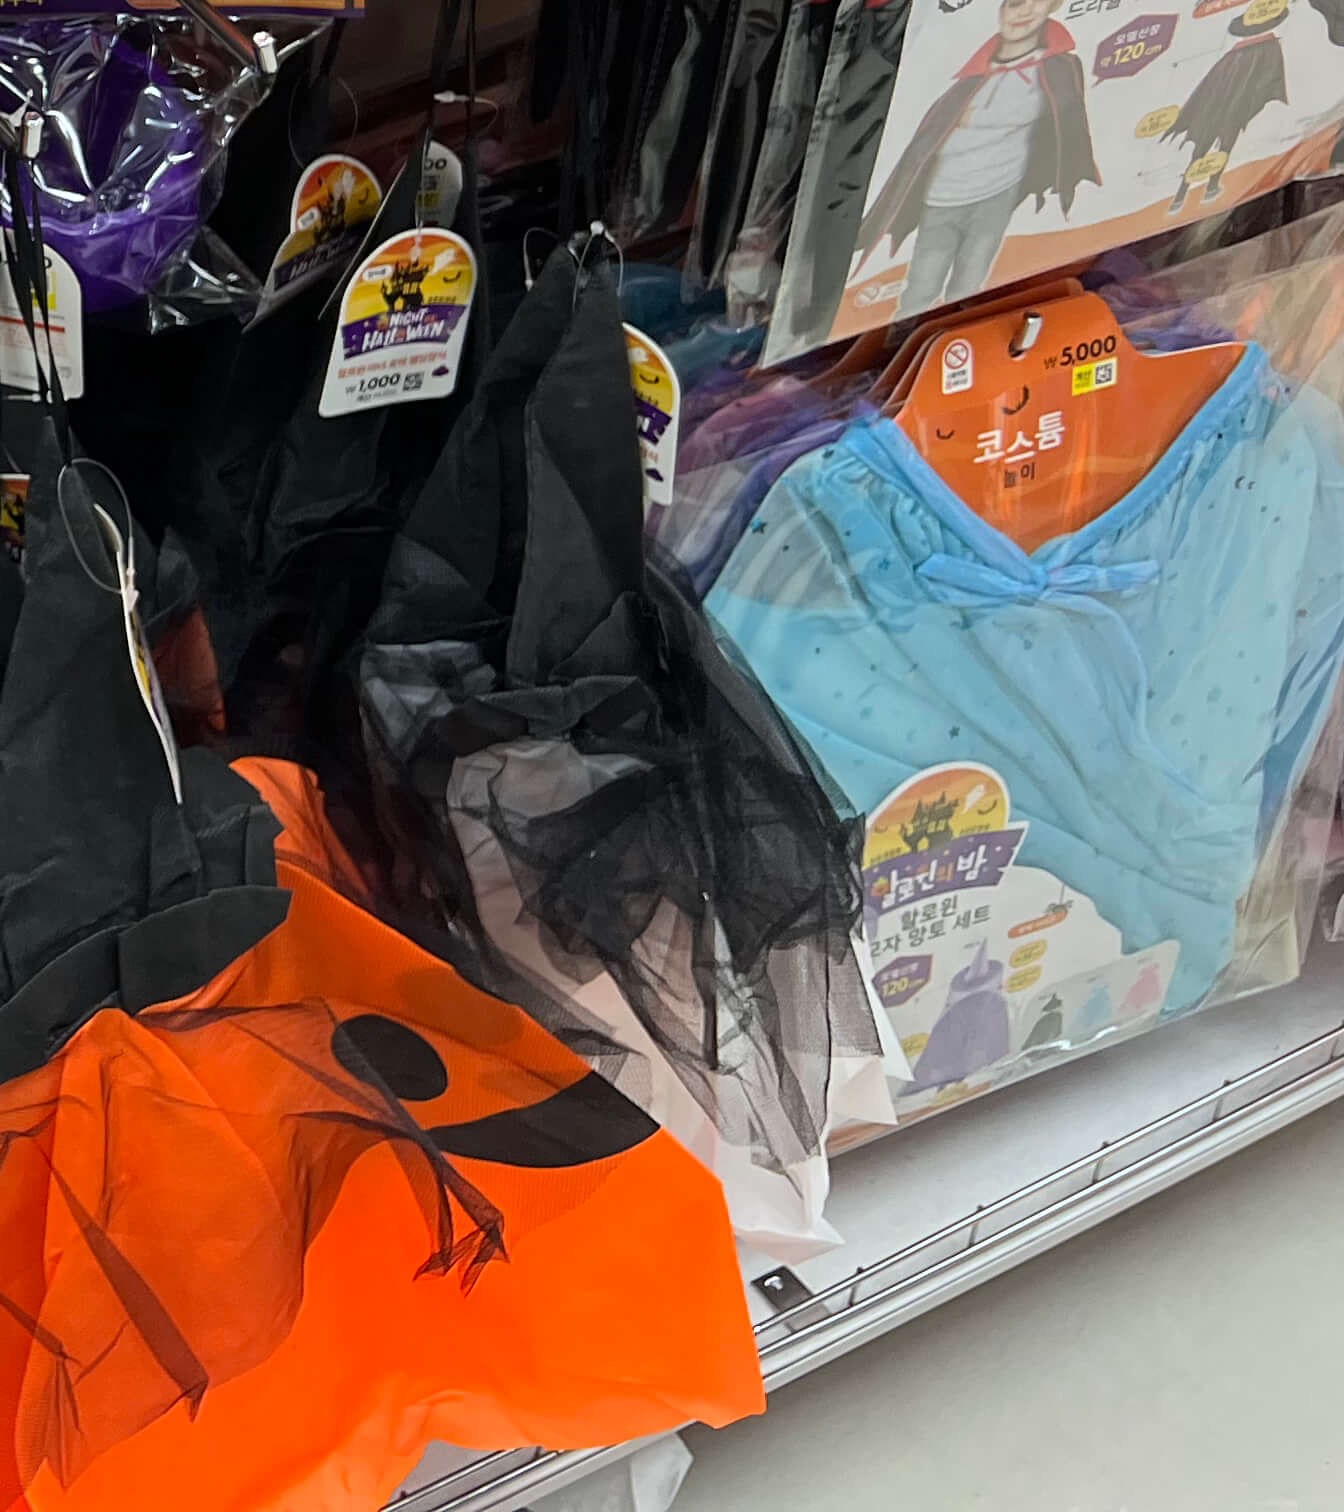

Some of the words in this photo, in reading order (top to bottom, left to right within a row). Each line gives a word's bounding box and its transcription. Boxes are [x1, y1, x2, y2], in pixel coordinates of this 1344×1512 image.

[1043, 335, 1118, 370] ₩5,000
[973, 410, 1066, 465] 코스튬
[957, 844, 988, 881] 밤
[901, 894, 960, 931] 할로윈
[907, 919, 946, 947] 망토
[951, 904, 992, 930] 세트
